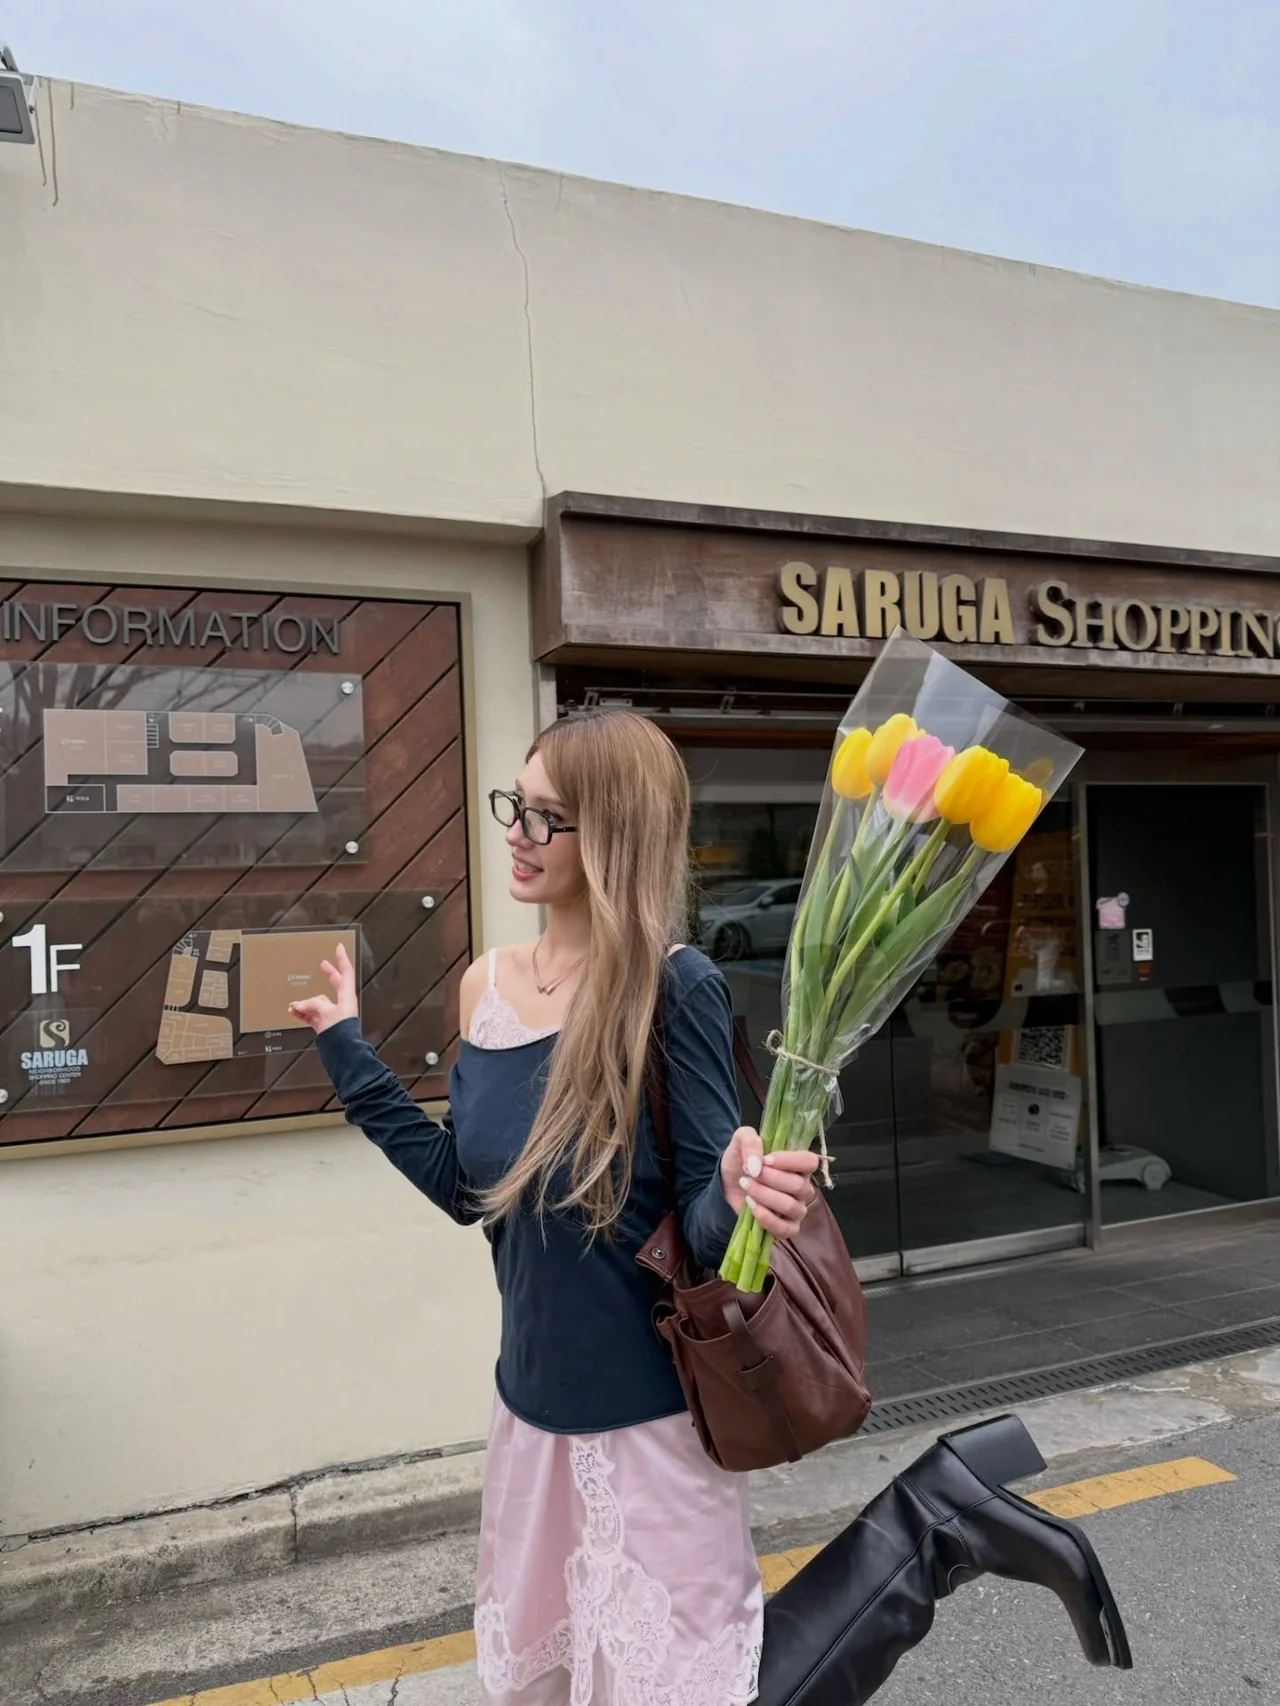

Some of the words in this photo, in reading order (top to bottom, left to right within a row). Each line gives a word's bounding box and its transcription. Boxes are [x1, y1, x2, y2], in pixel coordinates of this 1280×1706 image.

[3, 601, 341, 655] INFORMATION
[780, 560, 1015, 646] SARUGA
[12, 923, 83, 995] 1F
[20, 1049, 89, 1070] SARUGA
